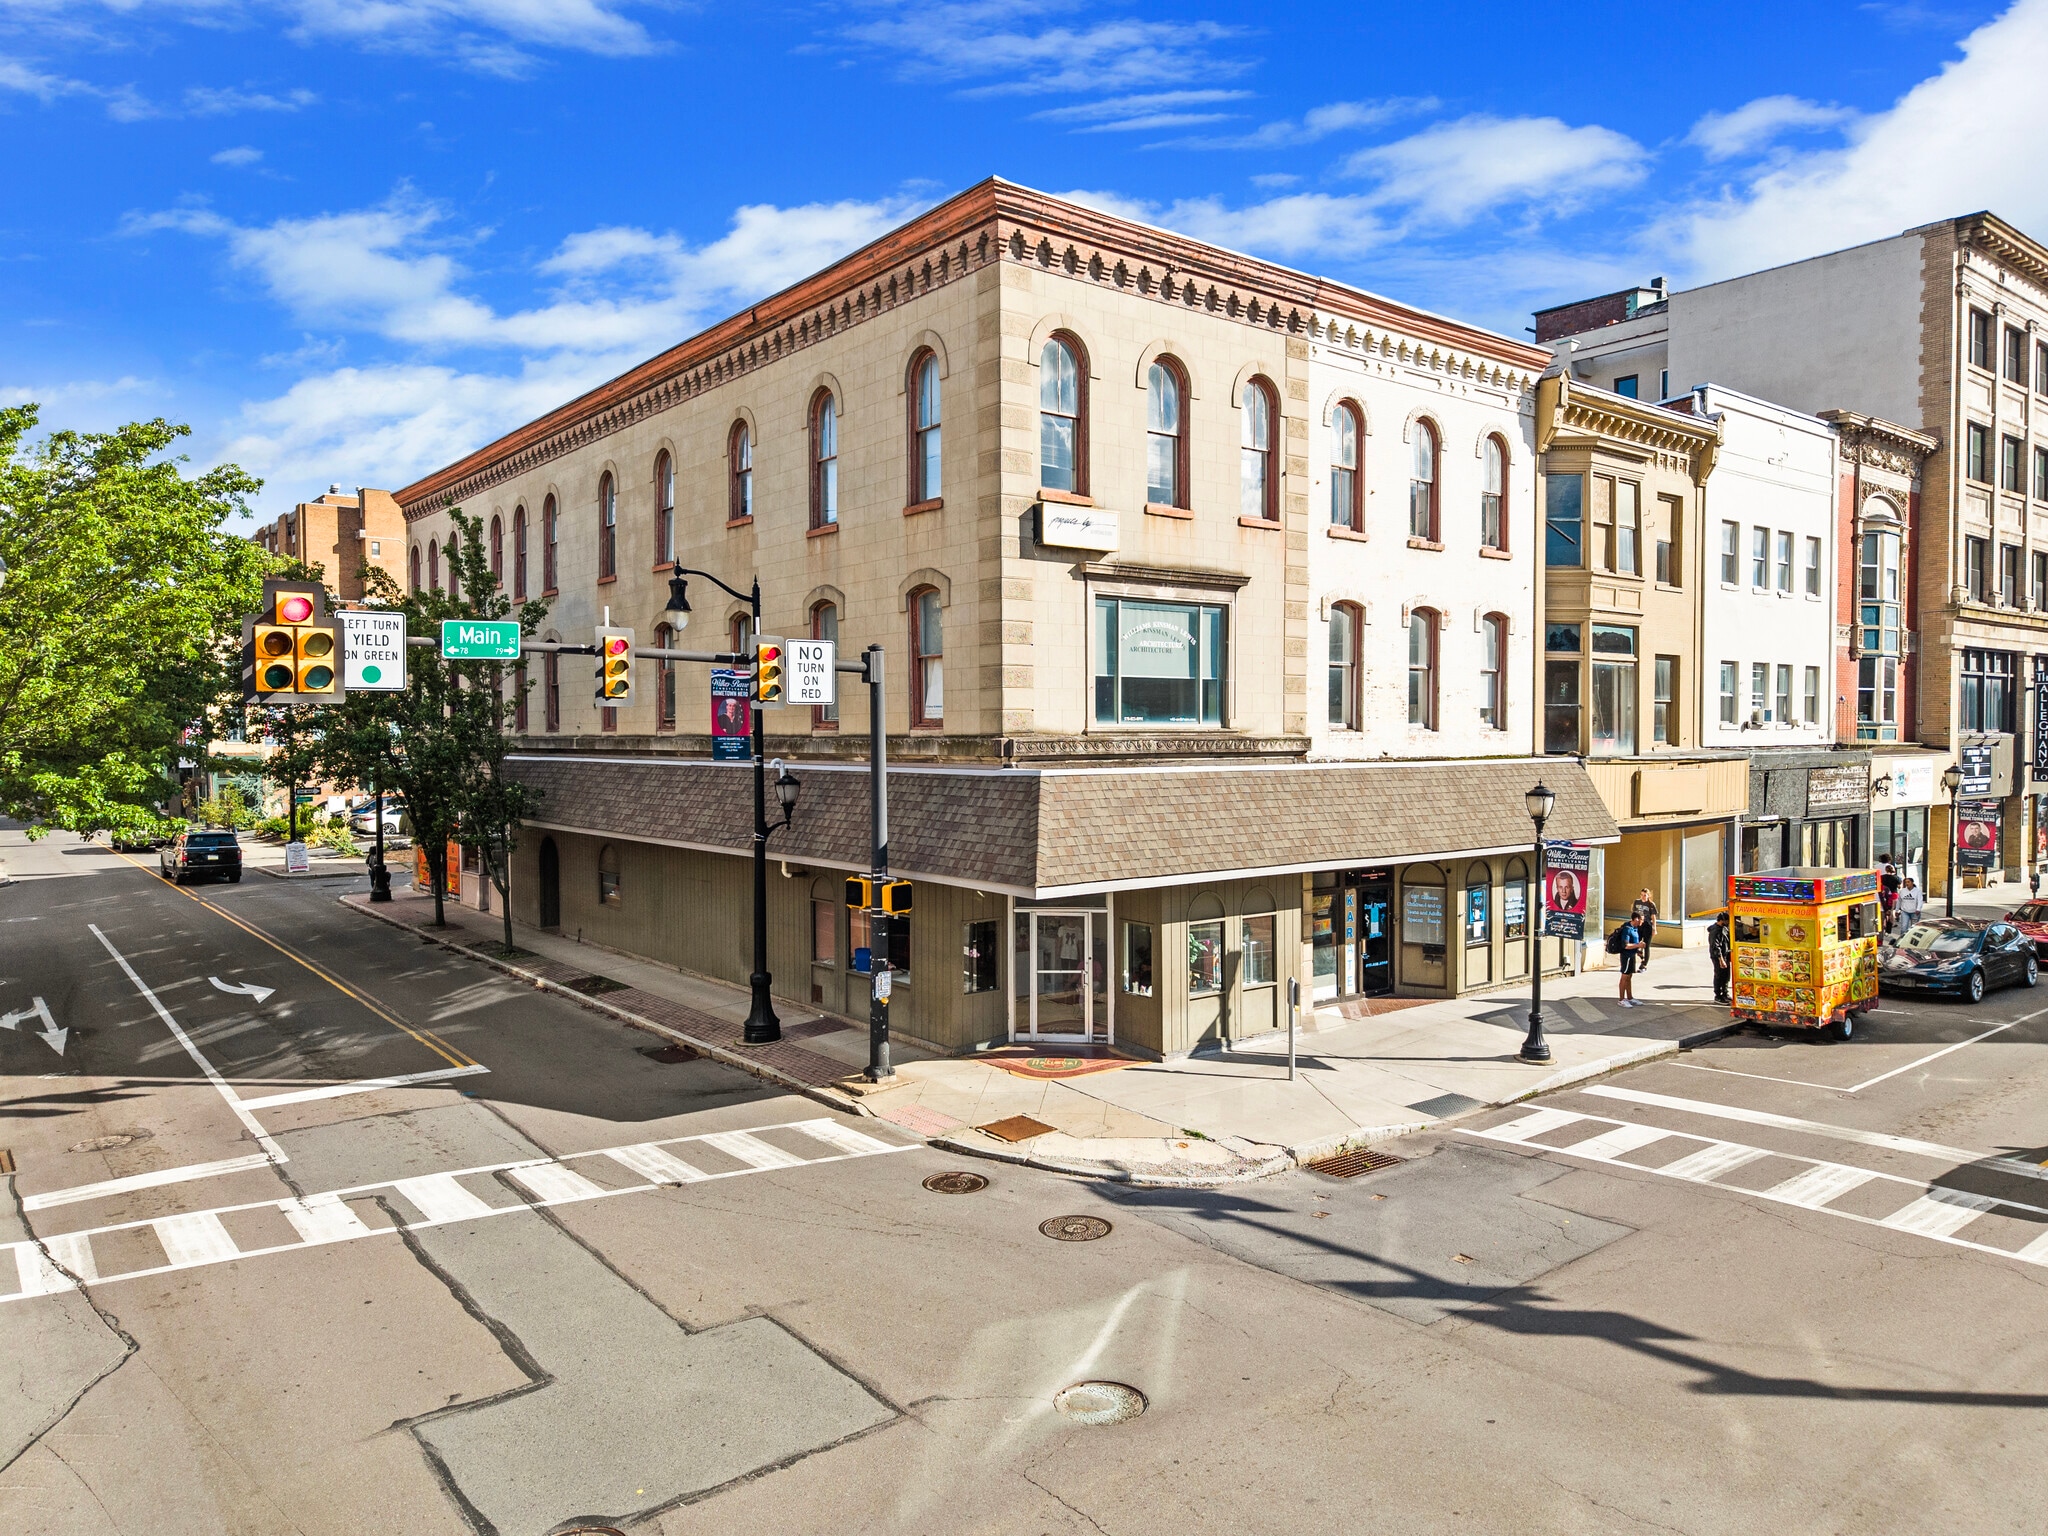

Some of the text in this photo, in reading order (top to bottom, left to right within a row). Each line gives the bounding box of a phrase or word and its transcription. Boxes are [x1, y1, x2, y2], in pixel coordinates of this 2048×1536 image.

[373, 620, 399, 630] TURN
[446, 636, 451, 644] S
[459, 625, 500, 644] Main
[1152, 621, 1179, 631] KINSMAN
[1179, 628, 1197, 645] LEWIS
[353, 633, 389, 646] YIELD
[344, 649, 398, 660] ON GREEN
[799, 646, 823, 660] NO
[797, 663, 825, 673] TURN
[803, 675, 819, 686] ON
[801, 688, 821, 698] RED
[1547, 861, 1575, 870] HOMETOWN
[1735, 905, 1765, 914] TAWAKAL
[1346, 894, 1354, 987] KARATE
